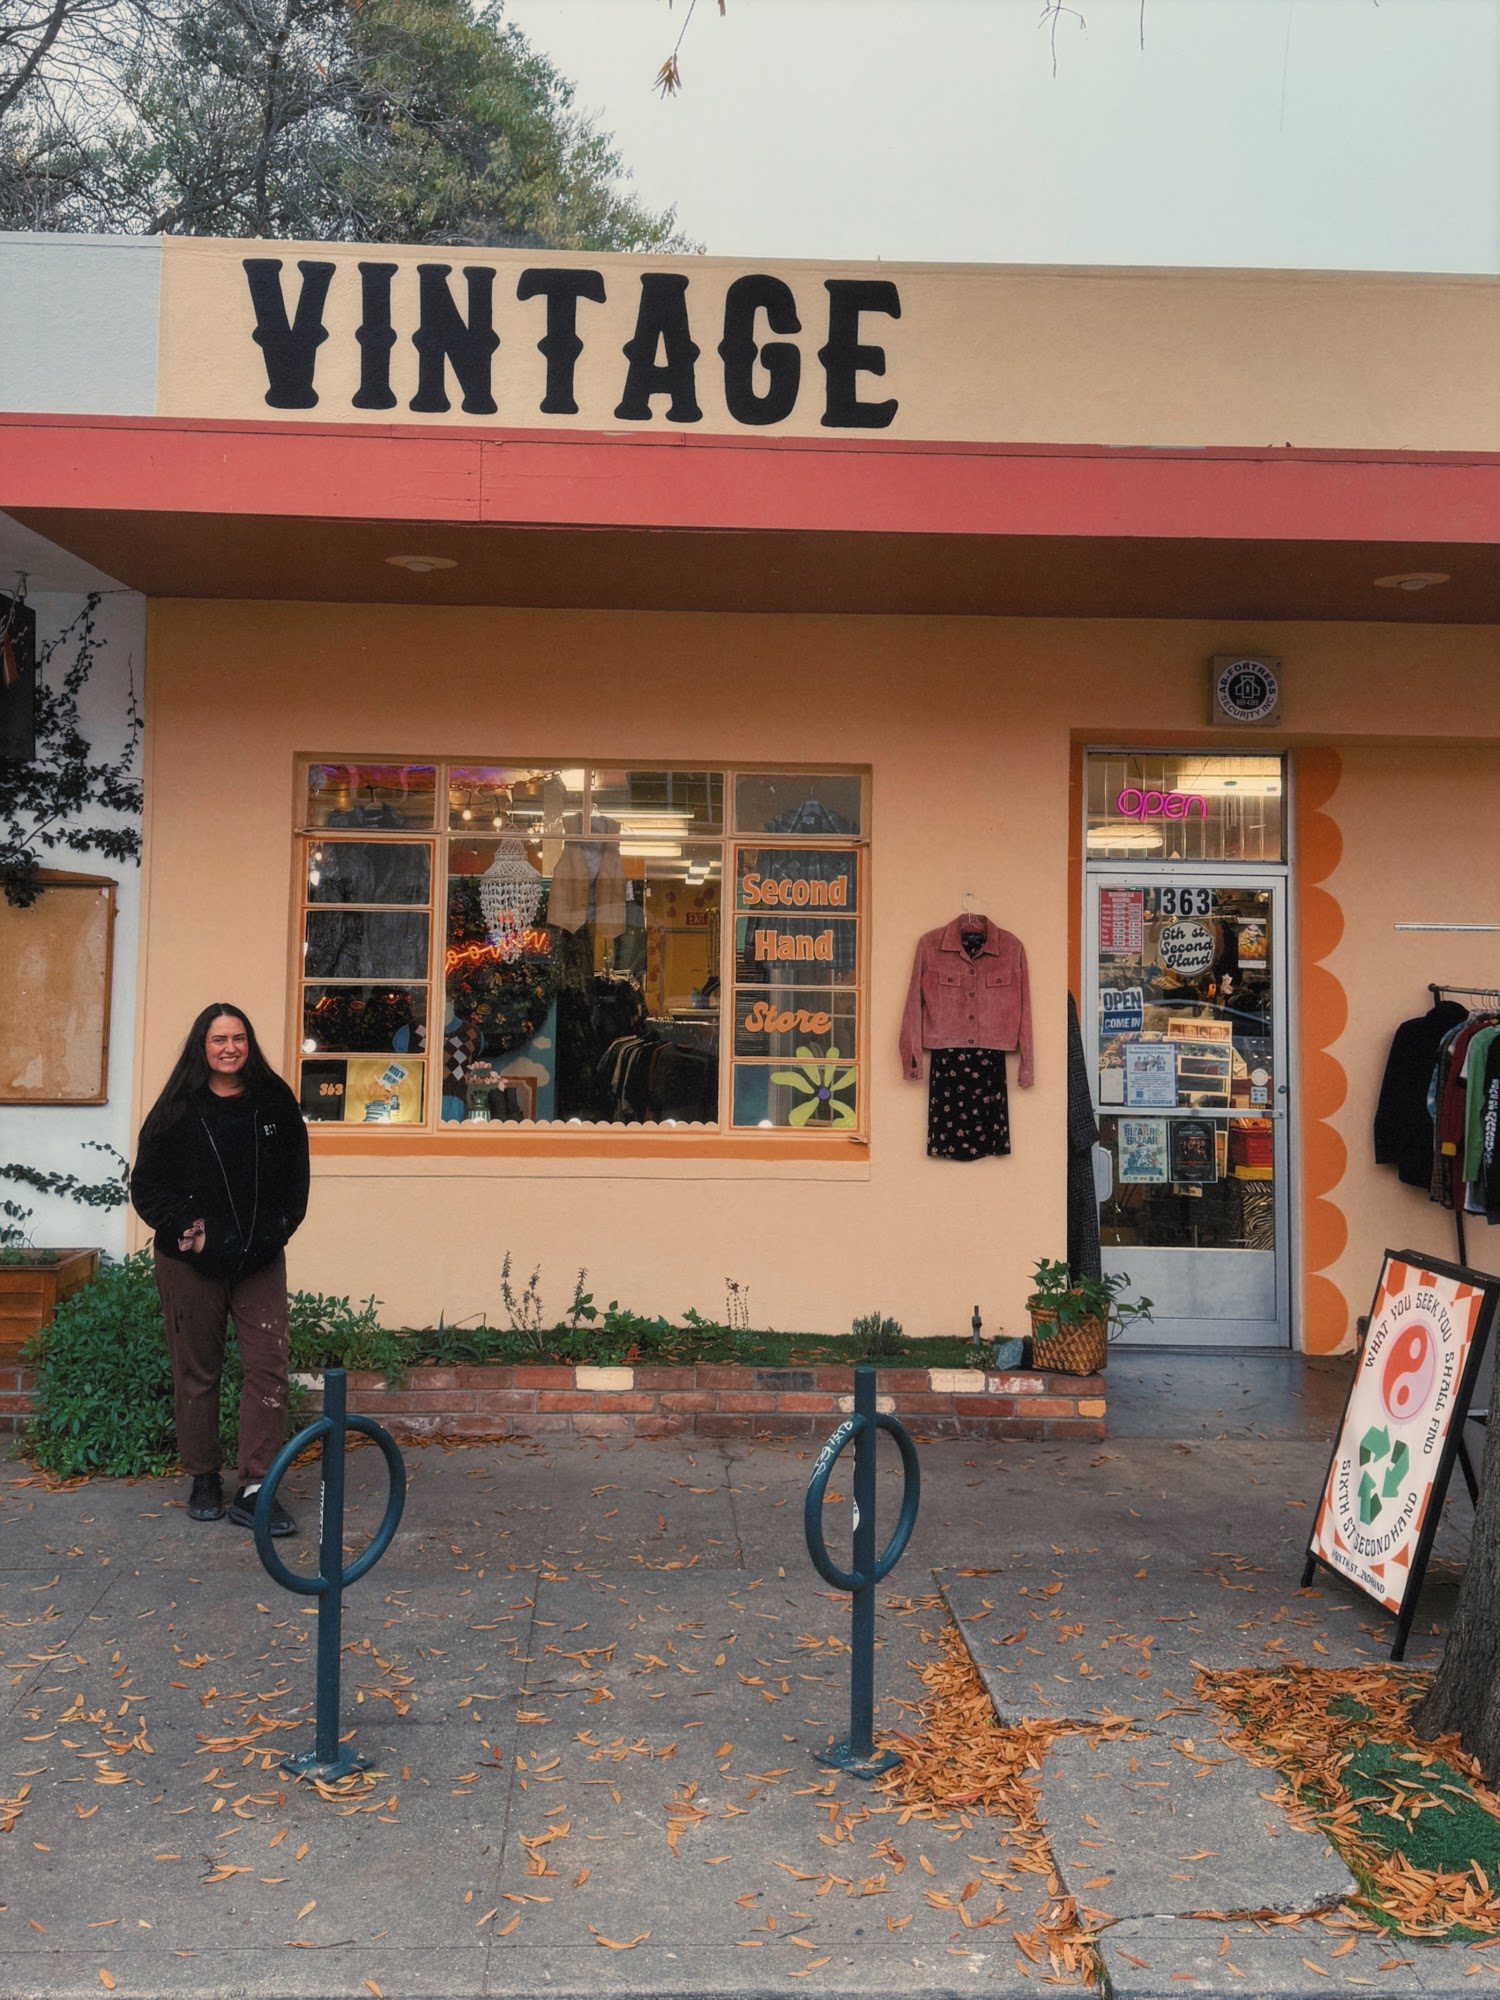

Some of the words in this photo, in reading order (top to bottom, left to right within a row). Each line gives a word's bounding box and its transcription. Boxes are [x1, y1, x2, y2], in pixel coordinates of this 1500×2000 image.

[242, 258, 902, 429] VINTAGE
[1227, 662, 1276, 695] FORTRESS
[1220, 695, 1261, 720] SECURITY
[1261, 696, 1274, 712] INC
[742, 873, 848, 907] Second
[1162, 887, 1211, 915] 363
[754, 929, 834, 961] Hand
[1162, 927, 1186, 940] 6th
[1191, 926, 1209, 938] st.
[1160, 938, 1213, 956] Second
[1166, 952, 1211, 969] Hand
[1103, 991, 1142, 1011] OPEN
[744, 1001, 832, 1035] Store
[1104, 1017, 1130, 1029] COME
[1131, 1017, 1140, 1028] IN
[319, 1083, 344, 1096] 363
[1124, 1127, 1160, 1137] BIZARRE
[1126, 1136, 1158, 1146] BAZAAR
[1390, 1294, 1412, 1320] YOU
[1415, 1292, 1440, 1317] SEEK
[1437, 1306, 1453, 1343] YOU
[1365, 1320, 1388, 1368] WHAT
[1434, 1352, 1455, 1412] SHALL
[1423, 1417, 1441, 1455] FIND
[1338, 1459, 1351, 1516] SIXTH
[1342, 1516, 1357, 1541] ST
